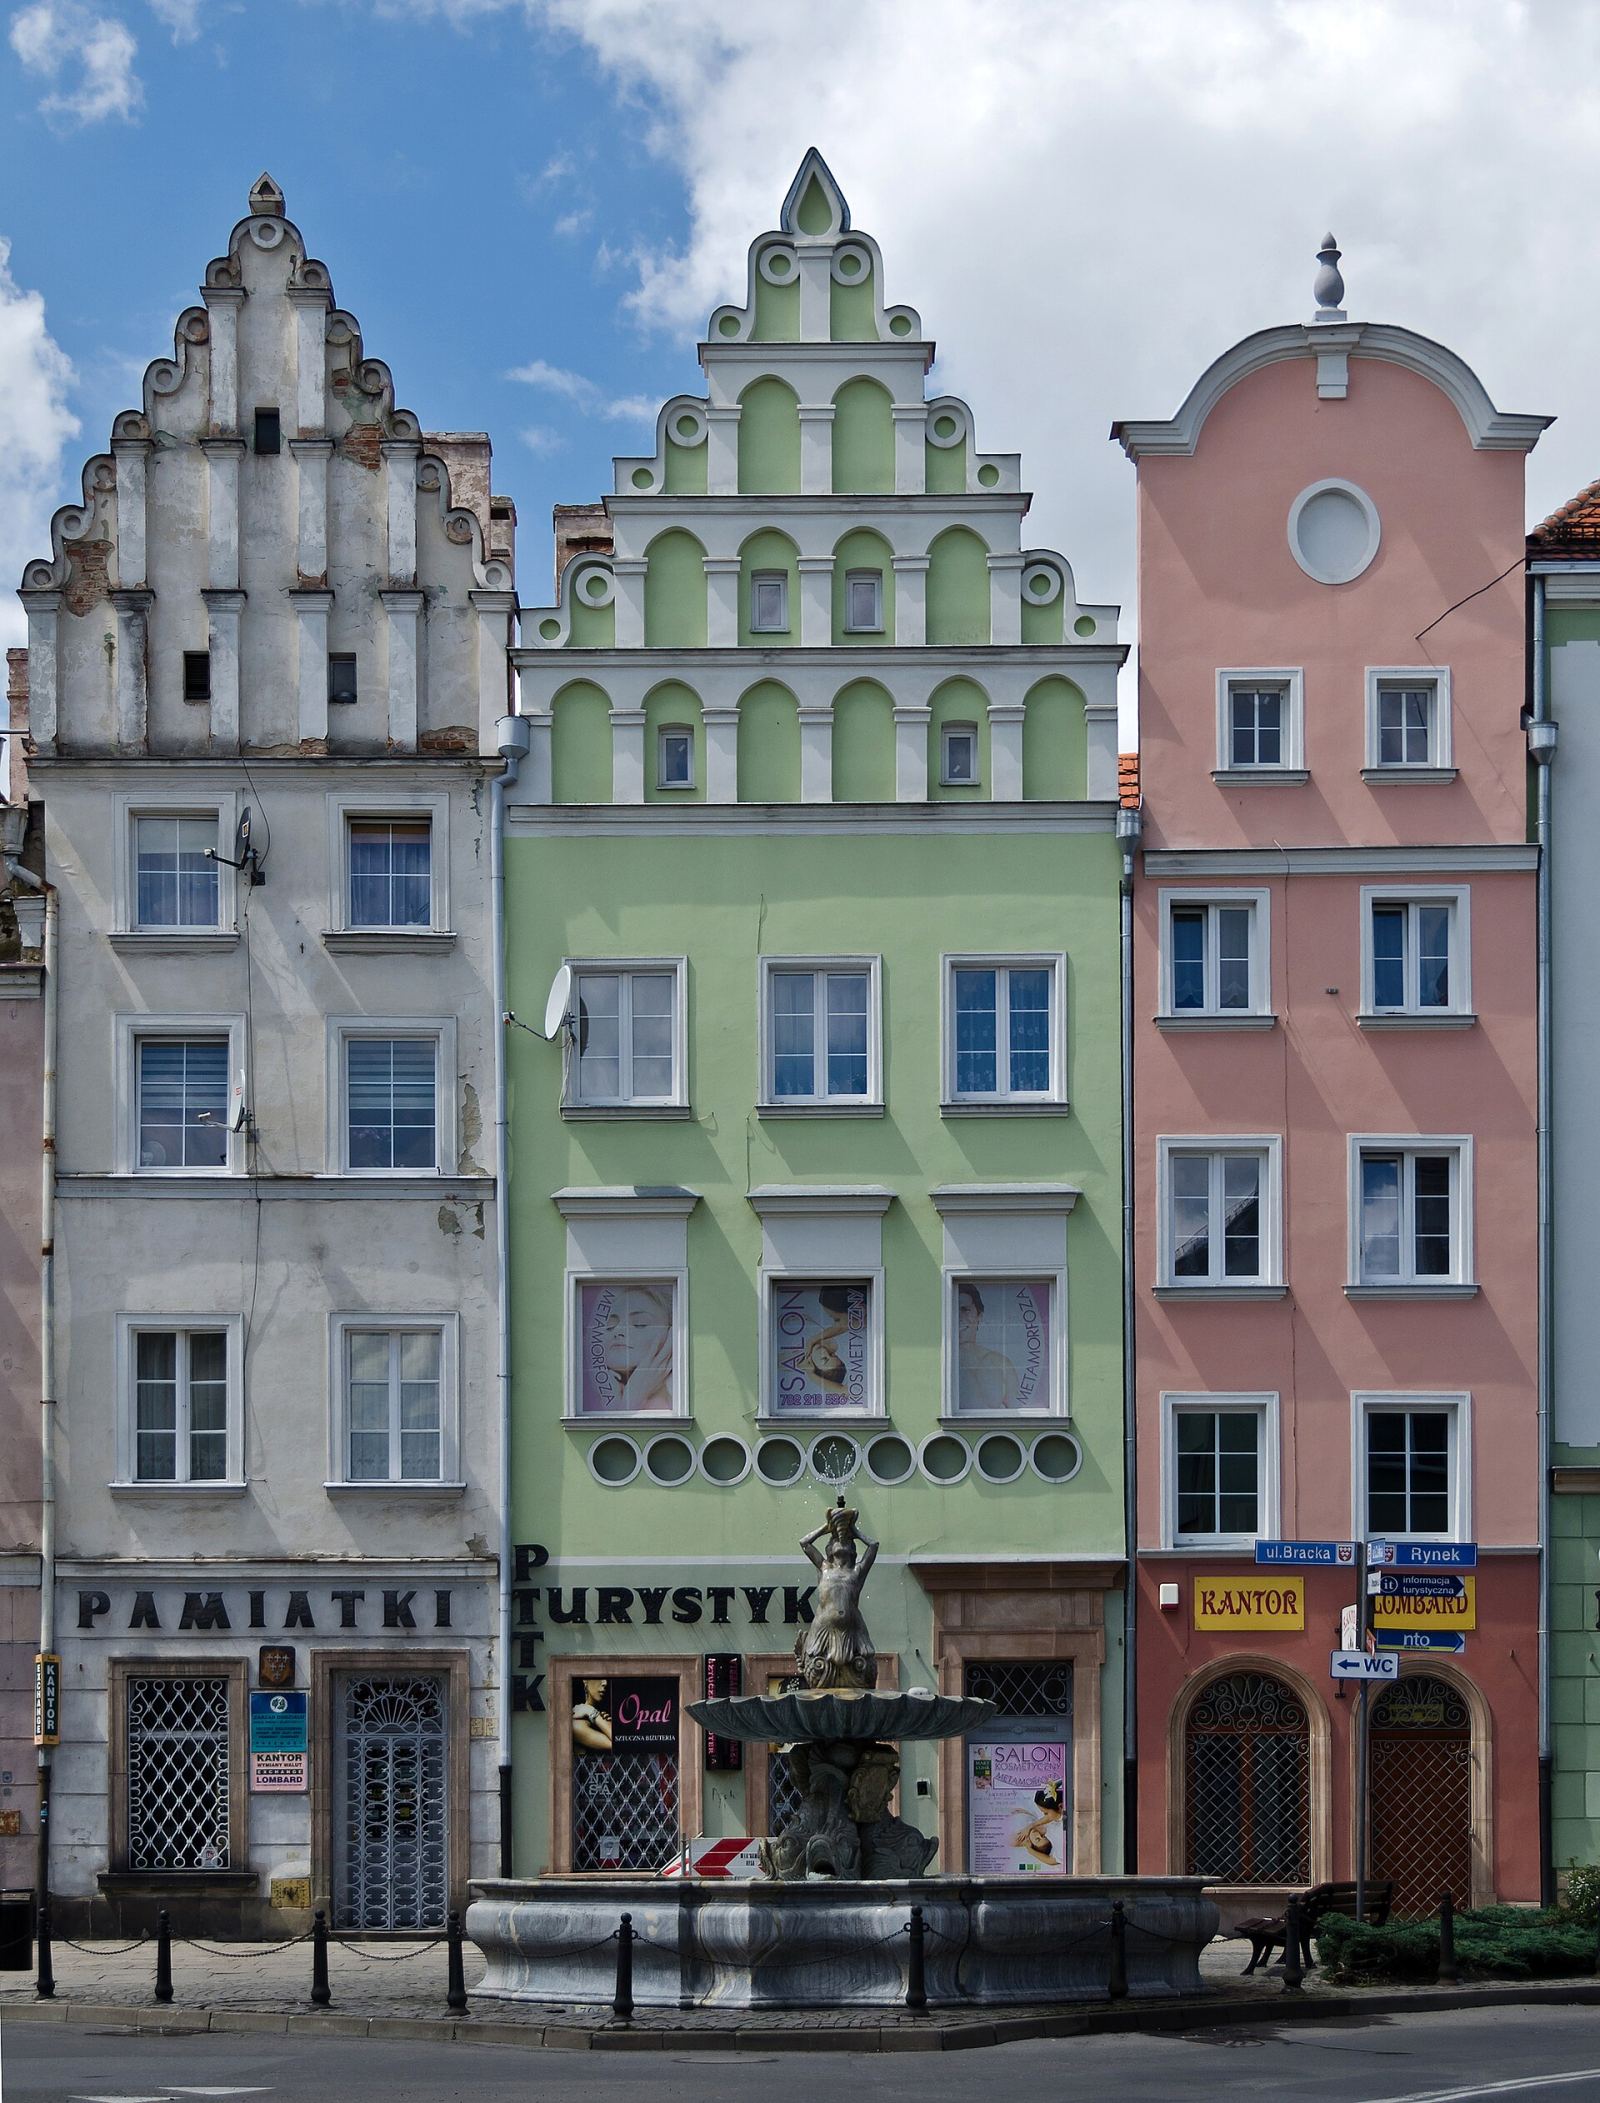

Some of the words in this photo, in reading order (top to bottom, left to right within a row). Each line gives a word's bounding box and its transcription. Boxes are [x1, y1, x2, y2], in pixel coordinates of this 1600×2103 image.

[591, 1288, 616, 1407] METAMORFOZA
[780, 1290, 806, 1391] SALON
[848, 1288, 864, 1405] KOSMETYCZNY
[1016, 1287, 1041, 1405] METAMORFOZA
[1411, 1547, 1460, 1564] Rynek
[1403, 1575, 1450, 1585] informacja
[1403, 1586, 1455, 1596] turystyczna
[1200, 1589, 1298, 1616] KANTOR
[1403, 1632, 1431, 1647] nto
[1364, 1658, 1393, 1673] WC
[46, 1664, 55, 1730] KANTOR
[618, 1694, 671, 1730] Opal
[257, 1754, 302, 1762] KANTOR
[995, 1746, 1061, 1762] SALON
[994, 1762, 1061, 1772] KOSMETYCZNY
